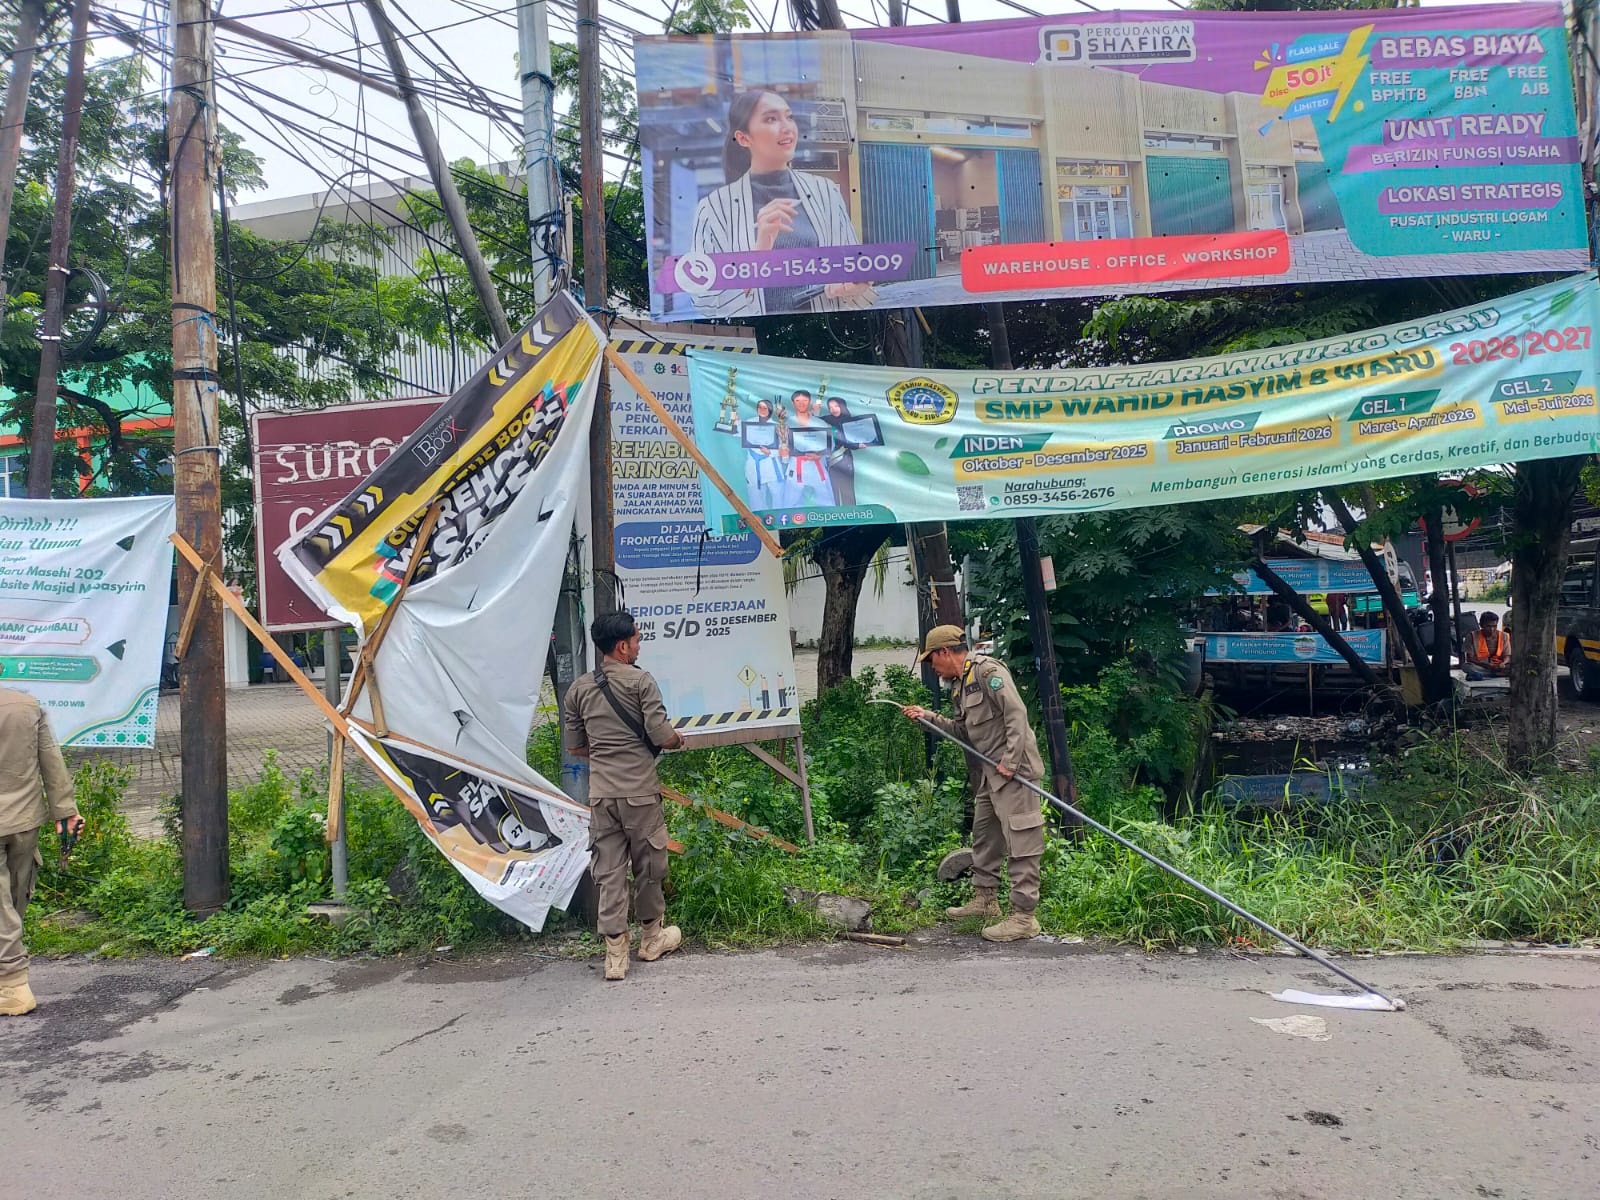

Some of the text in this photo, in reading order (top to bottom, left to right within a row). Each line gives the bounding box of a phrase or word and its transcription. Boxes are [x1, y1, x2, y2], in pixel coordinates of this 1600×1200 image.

[1087, 25, 1190, 37] PERGUDANGAN
[1087, 36, 1191, 52] SHAFIRA
[1288, 41, 1340, 57] FLASH SALE
[1381, 35, 1544, 59] BEBAS BIAYA
[1370, 66, 1548, 85] FREE FREE FREE
[1371, 82, 1549, 102] BPHTB BBN AJB
[1294, 98, 1329, 113] LIMITED
[1389, 114, 1545, 141] UNIT READY
[1371, 145, 1561, 165] BERIZIN FUNGSI USAHA
[1387, 183, 1563, 203] LOKASI STRATEGIS
[1389, 211, 1549, 227] PUSAT INDUSTRI LOGAM
[1452, 230, 1491, 242] WARU
[721, 253, 903, 280] 0816-1543-5009
[983, 257, 1090, 275] WAREHOUSE
[1106, 254, 1166, 269] OFFICE
[1182, 247, 1278, 264] WORKSHOP
[973, 356, 1261, 394] PENDAFTARAN
[1393, 307, 1501, 344] BARU
[1449, 326, 1592, 366] 2026/2027
[985, 399, 1053, 420] SMP
[1059, 391, 1174, 417] WAHID
[1181, 369, 1303, 407] HASYIM
[1334, 350, 1435, 380] WARU
[1500, 378, 1553, 397] GEL. 2
[1361, 397, 1406, 416] GEL. 1
[1503, 402, 1529, 415] Mei
[1539, 398, 1563, 411] Juli
[1565, 394, 1594, 408] 2026
[1174, 419, 1246, 437] PROMO
[1359, 421, 1398, 435] Maret
[1408, 413, 1439, 431] April
[1441, 408, 1476, 424] 2026
[964, 436, 1024, 453] INDEN
[1176, 436, 1229, 454] Januari
[1239, 429, 1297, 448] Februari
[1299, 426, 1332, 442] 2026
[275, 436, 408, 484] SURO
[963, 457, 1023, 473] Oktober
[1034, 449, 1111, 467] Desember
[1114, 444, 1147, 460] 2025
[1150, 475, 1237, 493] Membangun
[1241, 466, 1303, 483] Generasi
[1306, 461, 1348, 476] Islami
[1351, 455, 1386, 473] yang
[1390, 449, 1444, 465] Cerdas,
[1448, 440, 1499, 457] Kreatif,
[1504, 437, 1529, 450] dan
[624, 499, 652, 507] JALAN
[654, 499, 686, 507] AHMAD
[627, 491, 673, 499] SURABAYA
[1004, 487, 1115, 506] 0859-3456-2676
[807, 509, 873, 524] @speweha8
[661, 525, 672, 533] DI
[29, 537, 82, 550] Umum
[620, 535, 679, 545] FRONTAGE
[725, 533, 749, 542] YANI
[26, 565, 72, 578] Masehi
[75, 568, 105, 581] 202
[32, 579, 75, 595] Masjid
[687, 599, 765, 614] PEKERJAAN
[638, 613, 777, 639] UNI S/D 05 DESEMBER
[706, 627, 730, 637] 2025
[511, 824, 524, 839] 27
